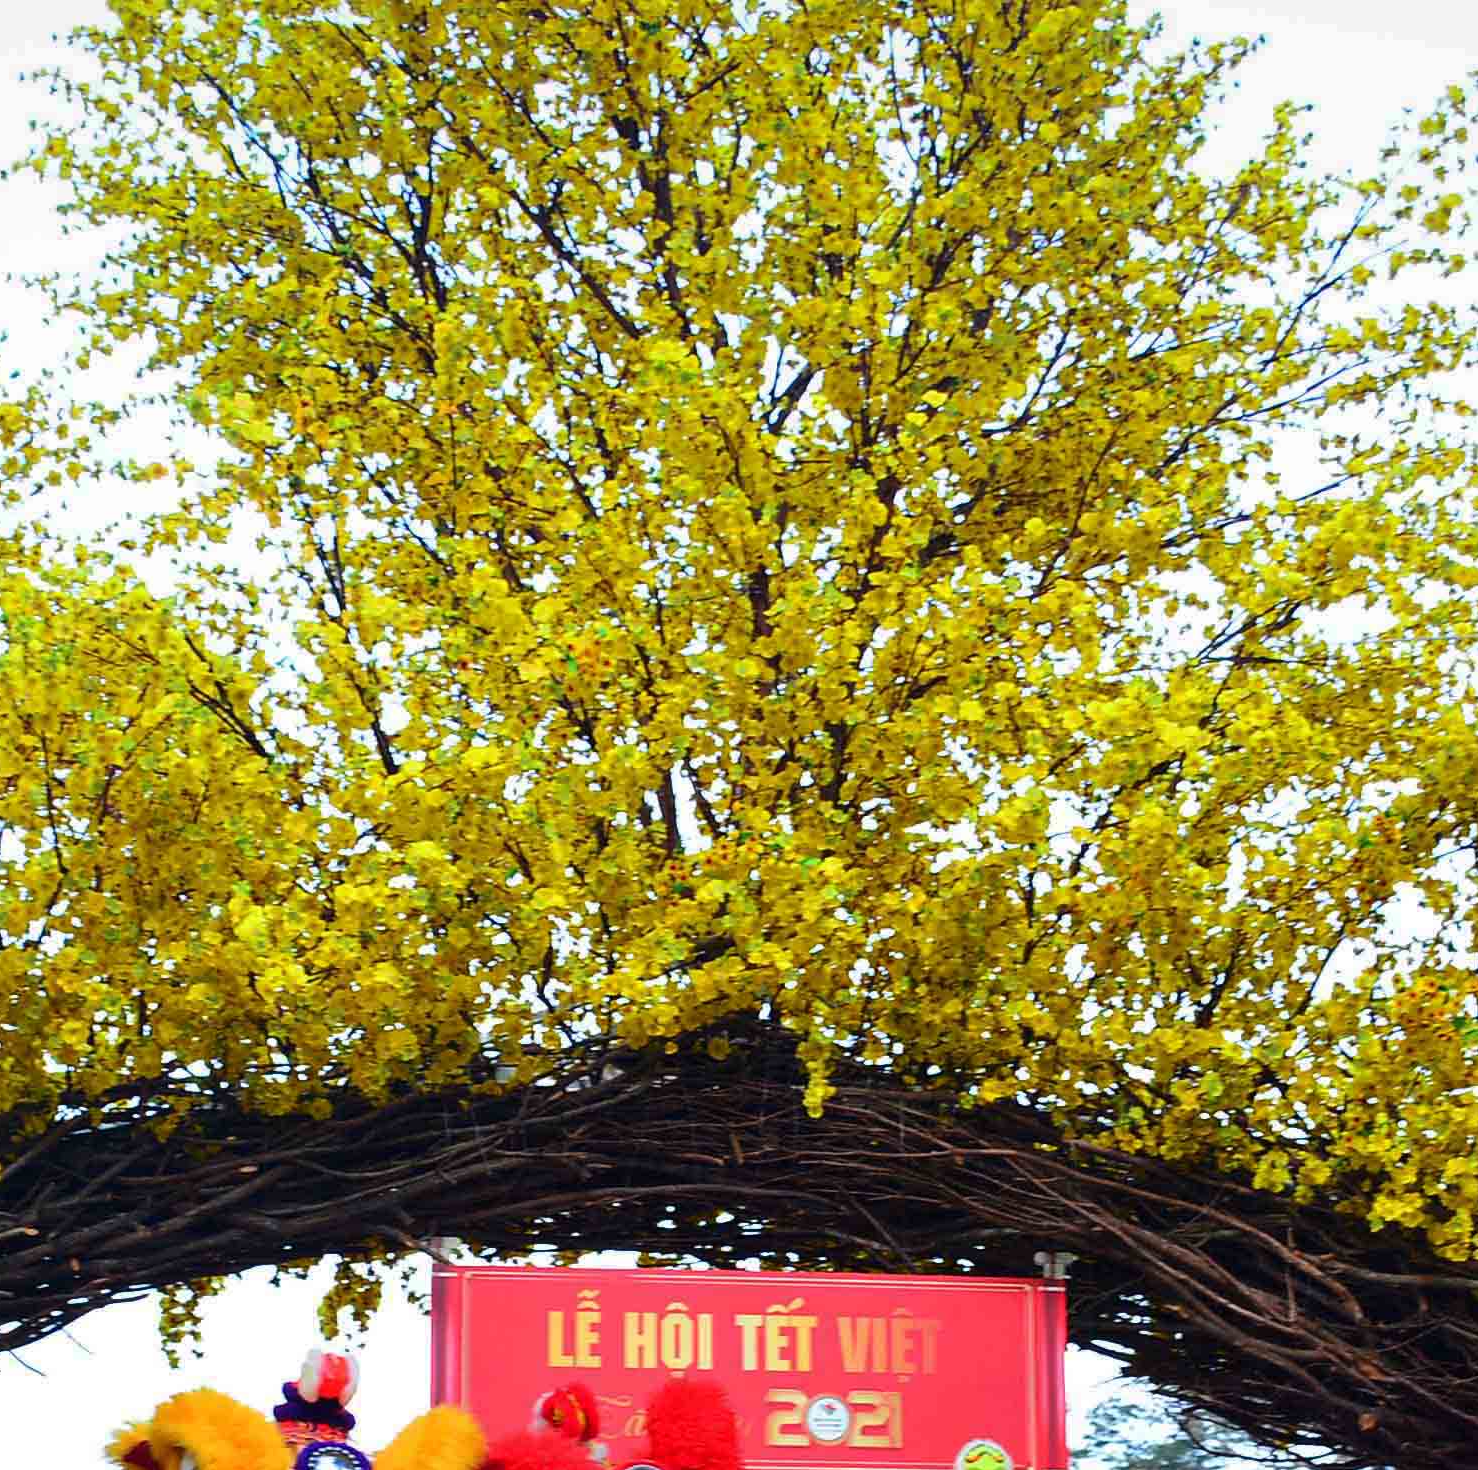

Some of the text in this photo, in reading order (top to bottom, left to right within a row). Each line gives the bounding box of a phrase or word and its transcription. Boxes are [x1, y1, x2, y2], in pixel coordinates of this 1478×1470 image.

[547, 1289, 942, 1384] LỄ HỘI TẾT VIỆT
[764, 1388, 903, 1449] 2021
